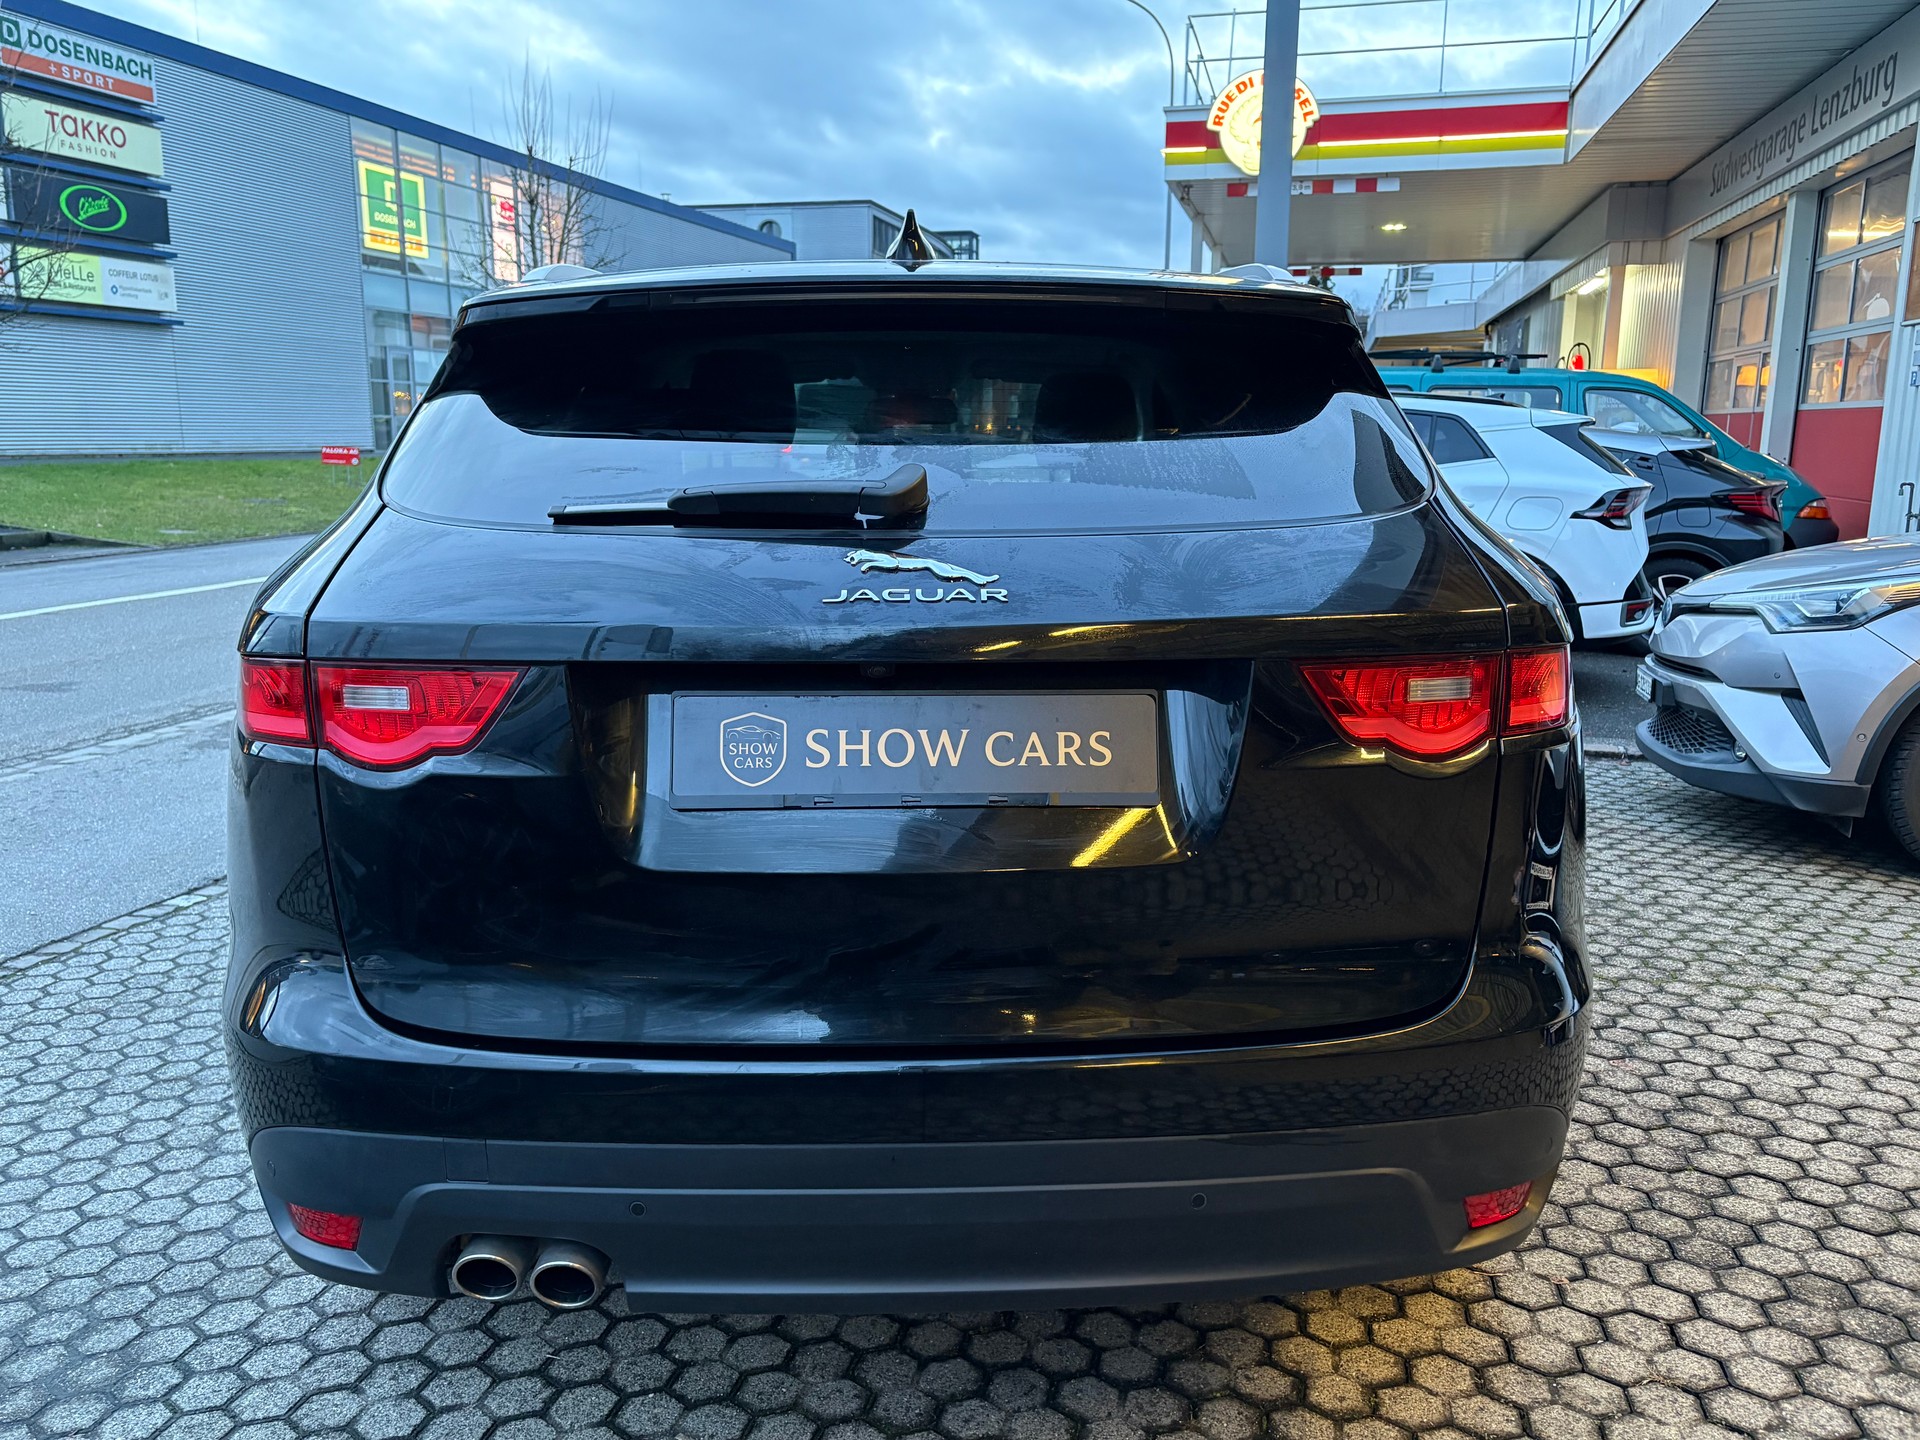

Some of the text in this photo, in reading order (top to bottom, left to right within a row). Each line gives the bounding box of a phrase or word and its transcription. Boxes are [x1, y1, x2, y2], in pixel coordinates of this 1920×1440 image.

[28, 28, 153, 81] DOSENBACH
[61, 66, 115, 90] SPORT
[1212, 76, 1255, 127] RUEDI
[1710, 51, 1899, 197] Südwestgarage Lenzburg
[60, 139, 117, 159] FASHION
[822, 588, 1009, 603] JAGUAR
[728, 742, 778, 755] SHOW
[805, 728, 1113, 768] SHOW CARS
[734, 757, 773, 769] CARS
